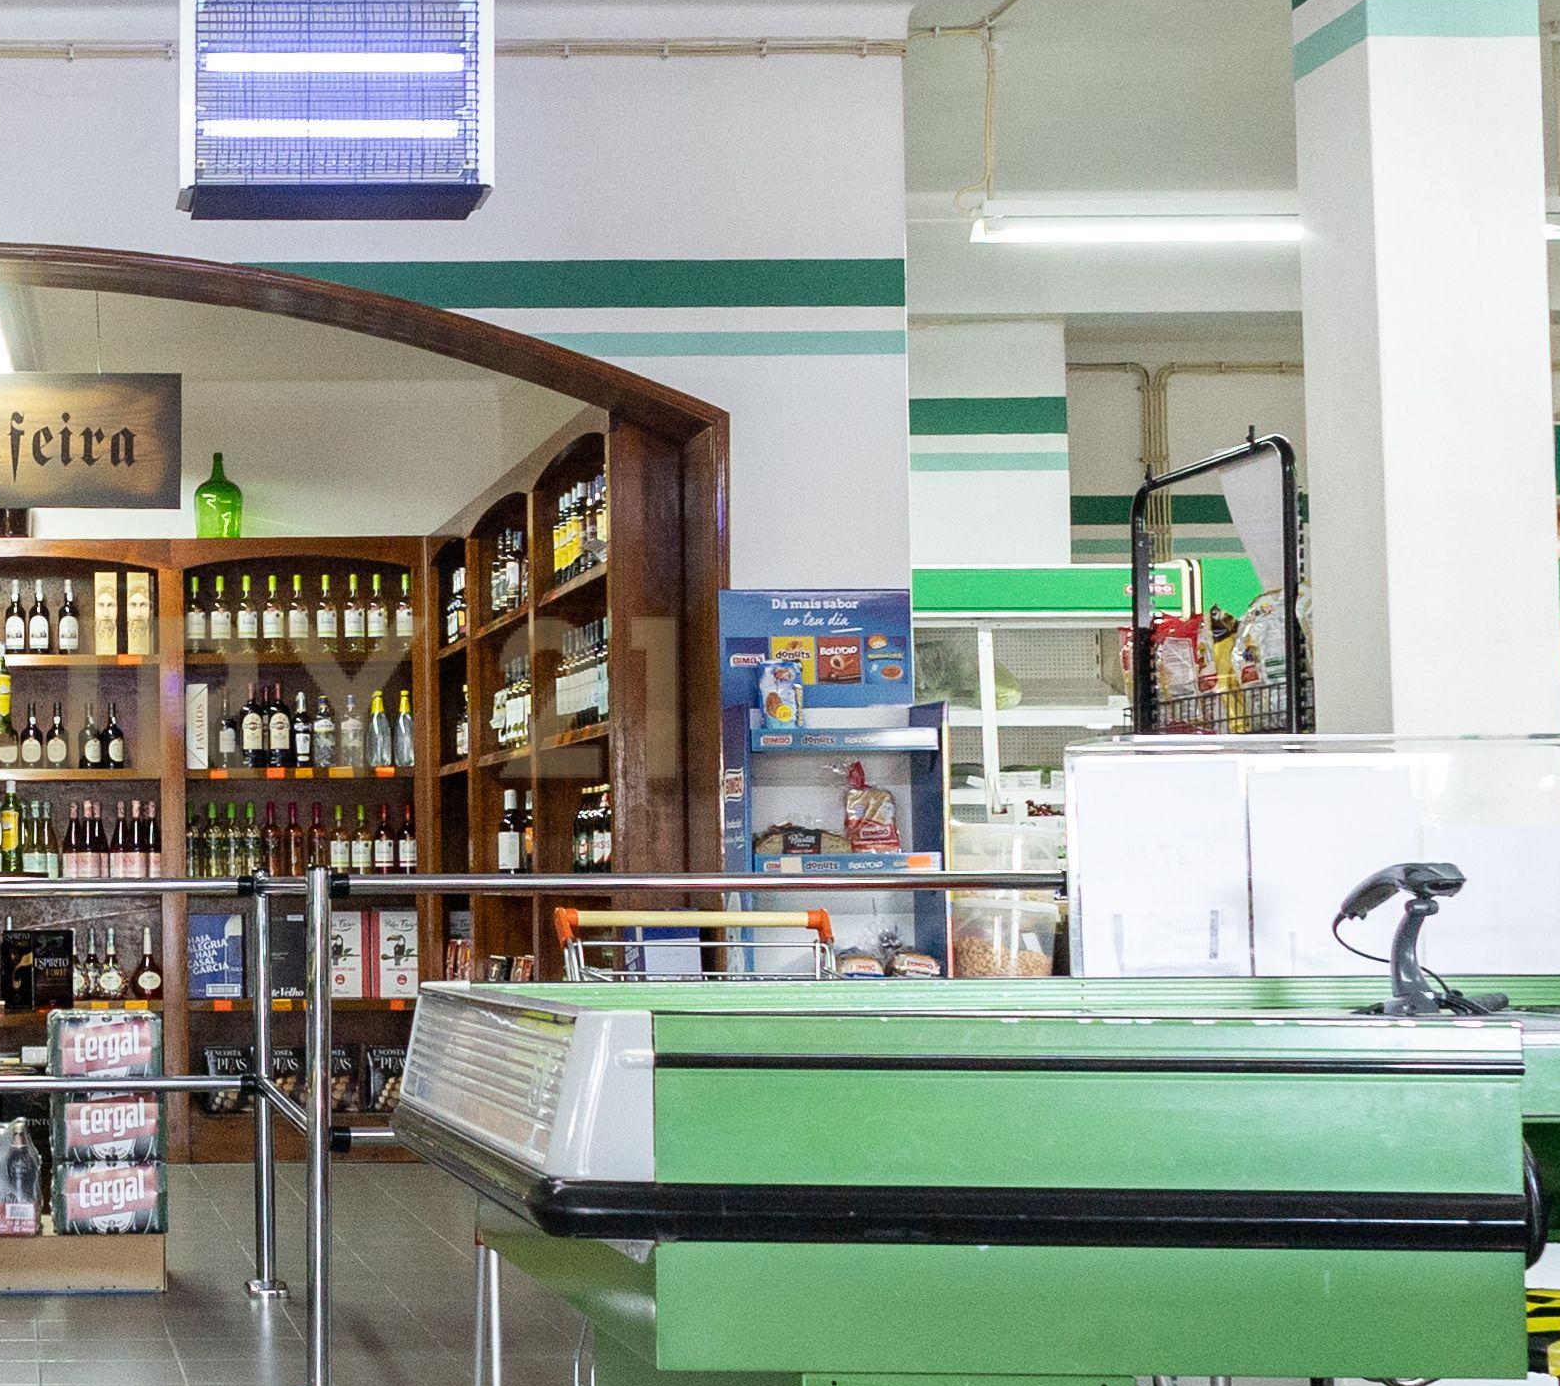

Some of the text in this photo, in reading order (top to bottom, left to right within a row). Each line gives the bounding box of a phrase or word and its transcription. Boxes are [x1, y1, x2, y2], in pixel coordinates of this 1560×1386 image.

[772, 598, 859, 609] Dá mais sabor
[828, 614, 849, 626] dia
[775, 650, 811, 660] donuts
[805, 861, 840, 870] donuts
[74, 1024, 140, 1065] Cergal
[80, 1096, 146, 1138] Cergal
[79, 1169, 145, 1211] Cergal
